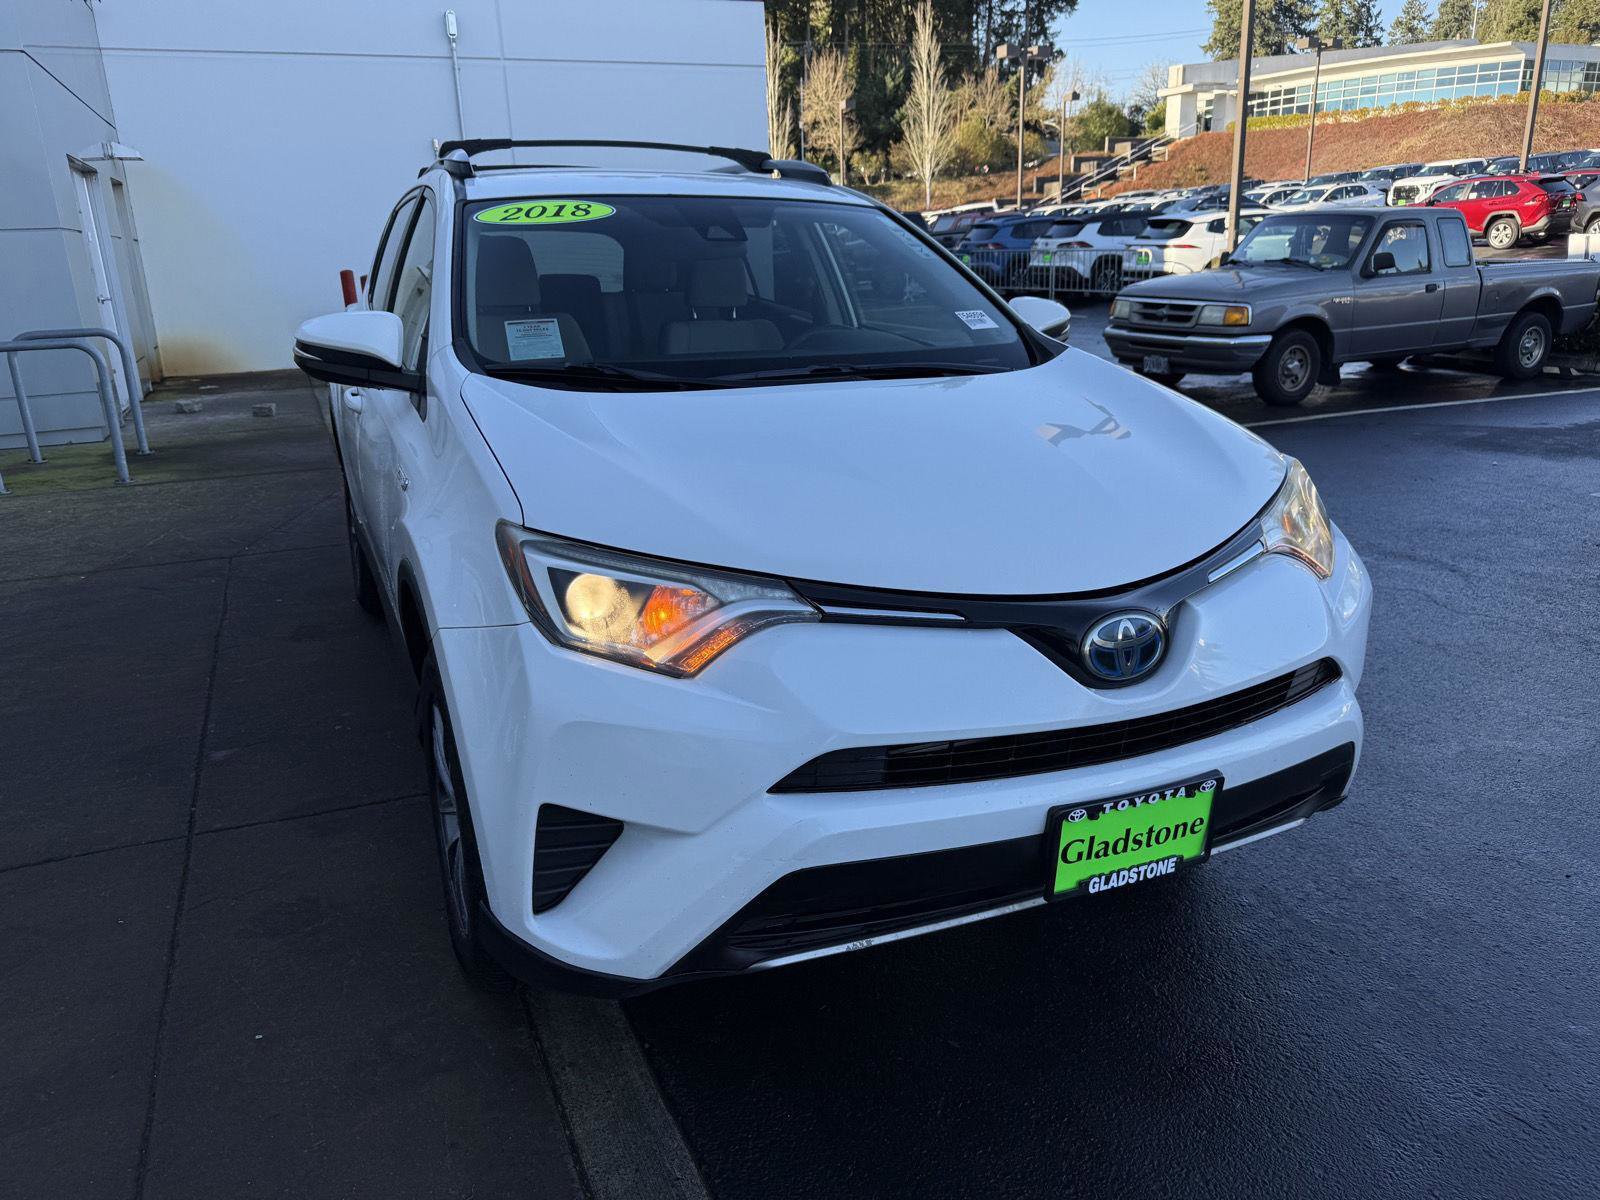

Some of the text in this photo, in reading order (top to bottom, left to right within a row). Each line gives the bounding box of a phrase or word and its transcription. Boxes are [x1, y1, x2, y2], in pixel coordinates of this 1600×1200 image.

[500, 203, 592, 221] 2018
[1103, 787, 1186, 814] TOYOTA
[1060, 816, 1205, 865] Gladstone
[1088, 857, 1177, 894] GLADSTONE
